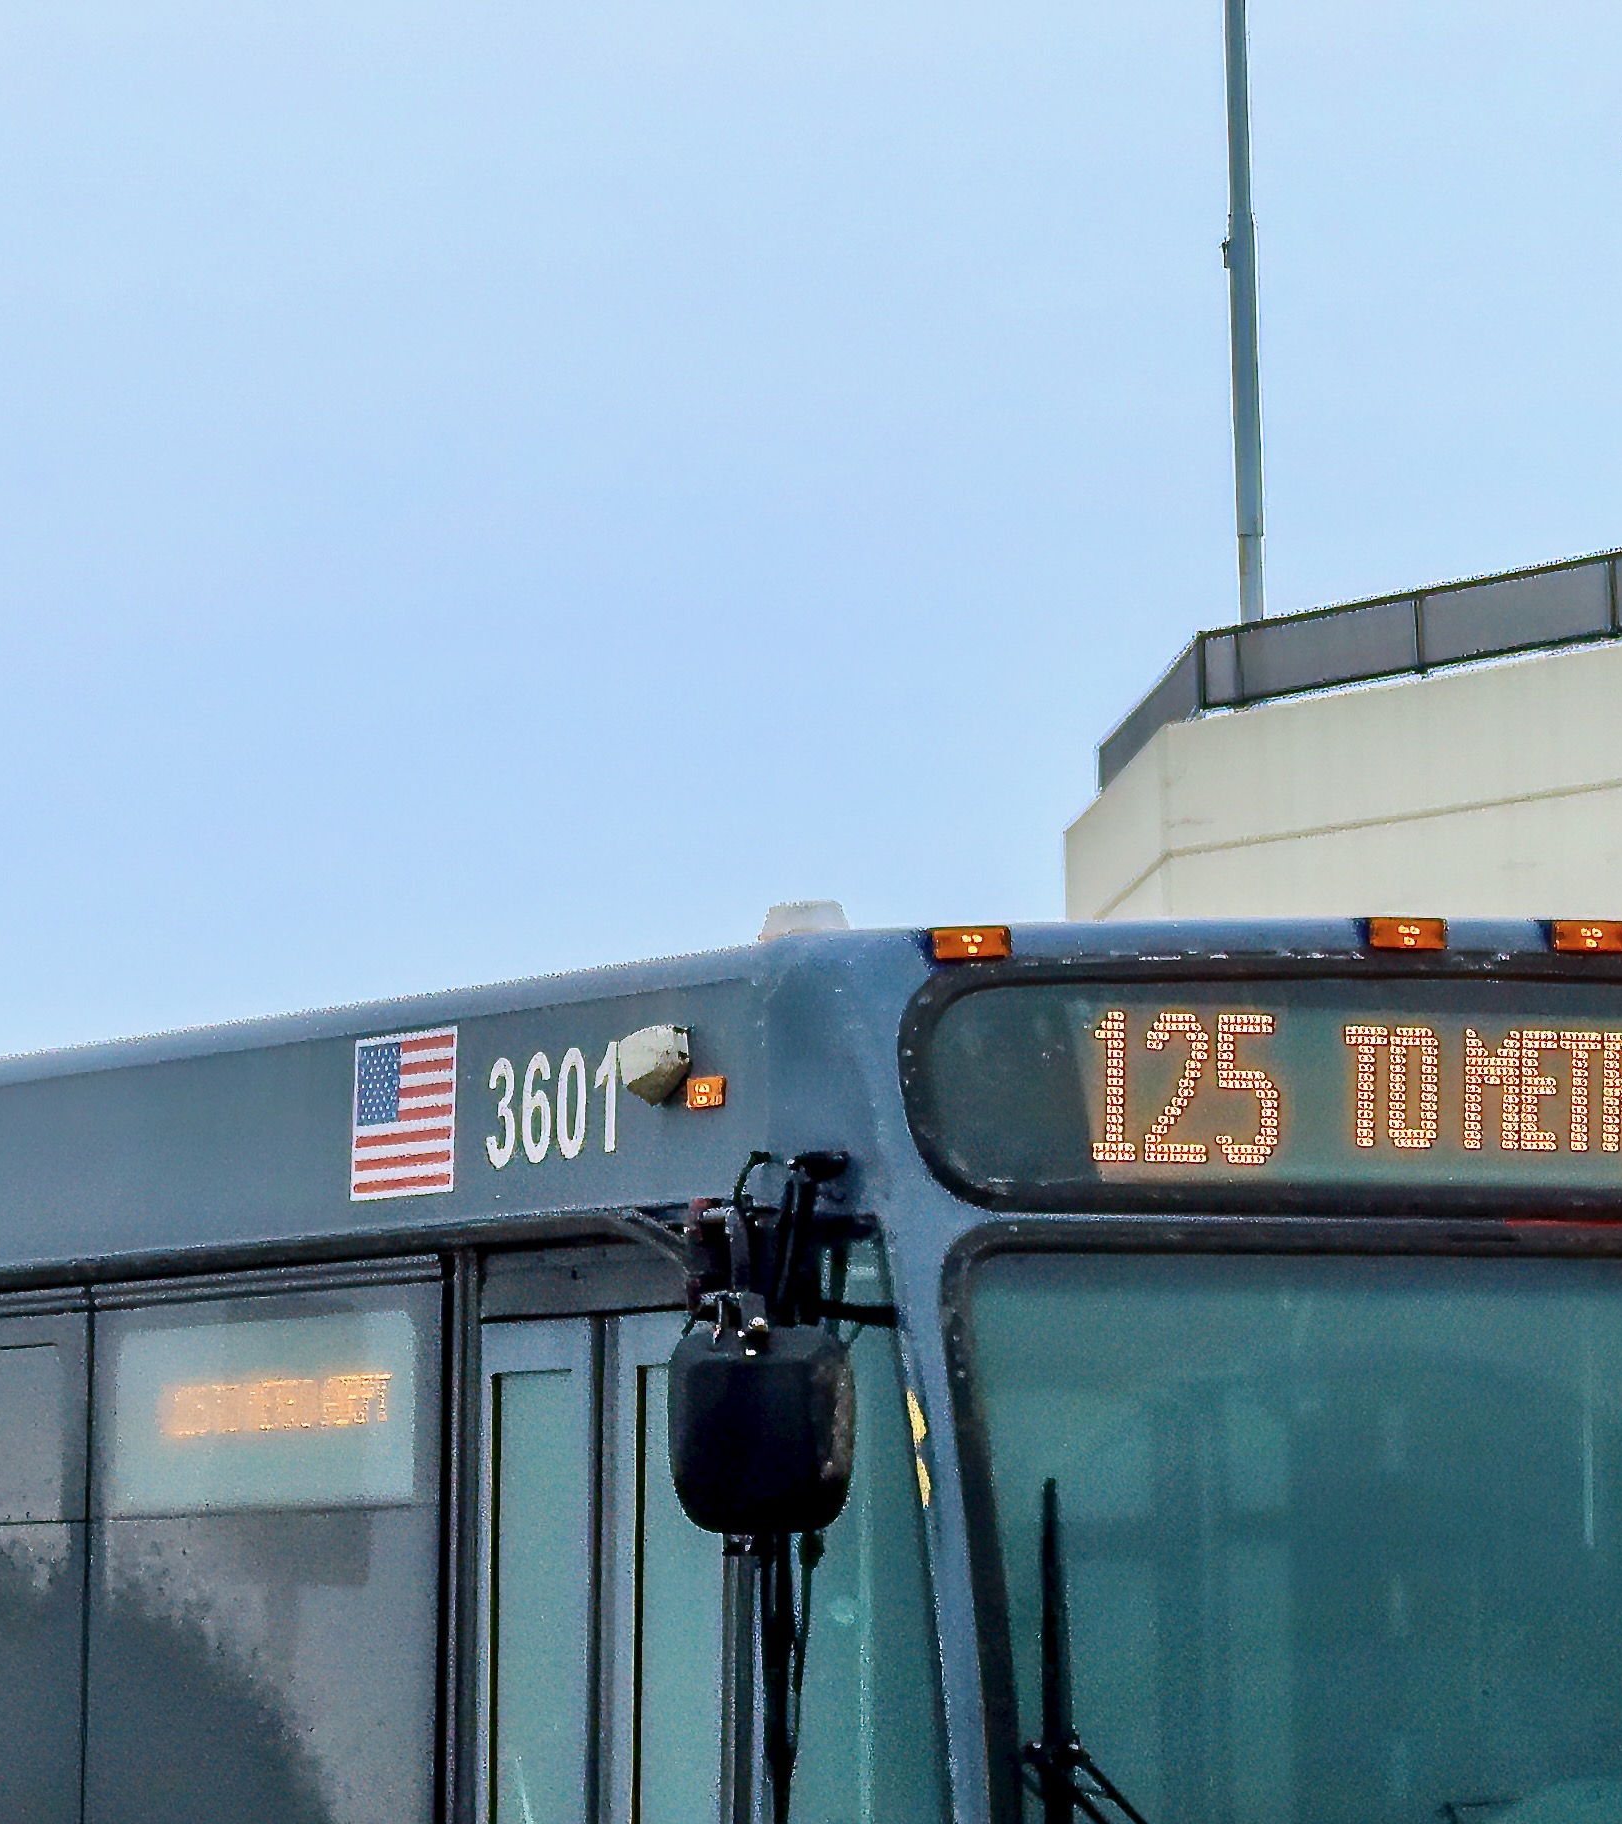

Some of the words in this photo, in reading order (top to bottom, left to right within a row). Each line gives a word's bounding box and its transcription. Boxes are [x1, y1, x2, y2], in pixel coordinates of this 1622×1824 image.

[486, 1041, 617, 1169] 3601
[1092, 1010, 1277, 1164] 125
[1344, 1025, 1438, 1148] TO
